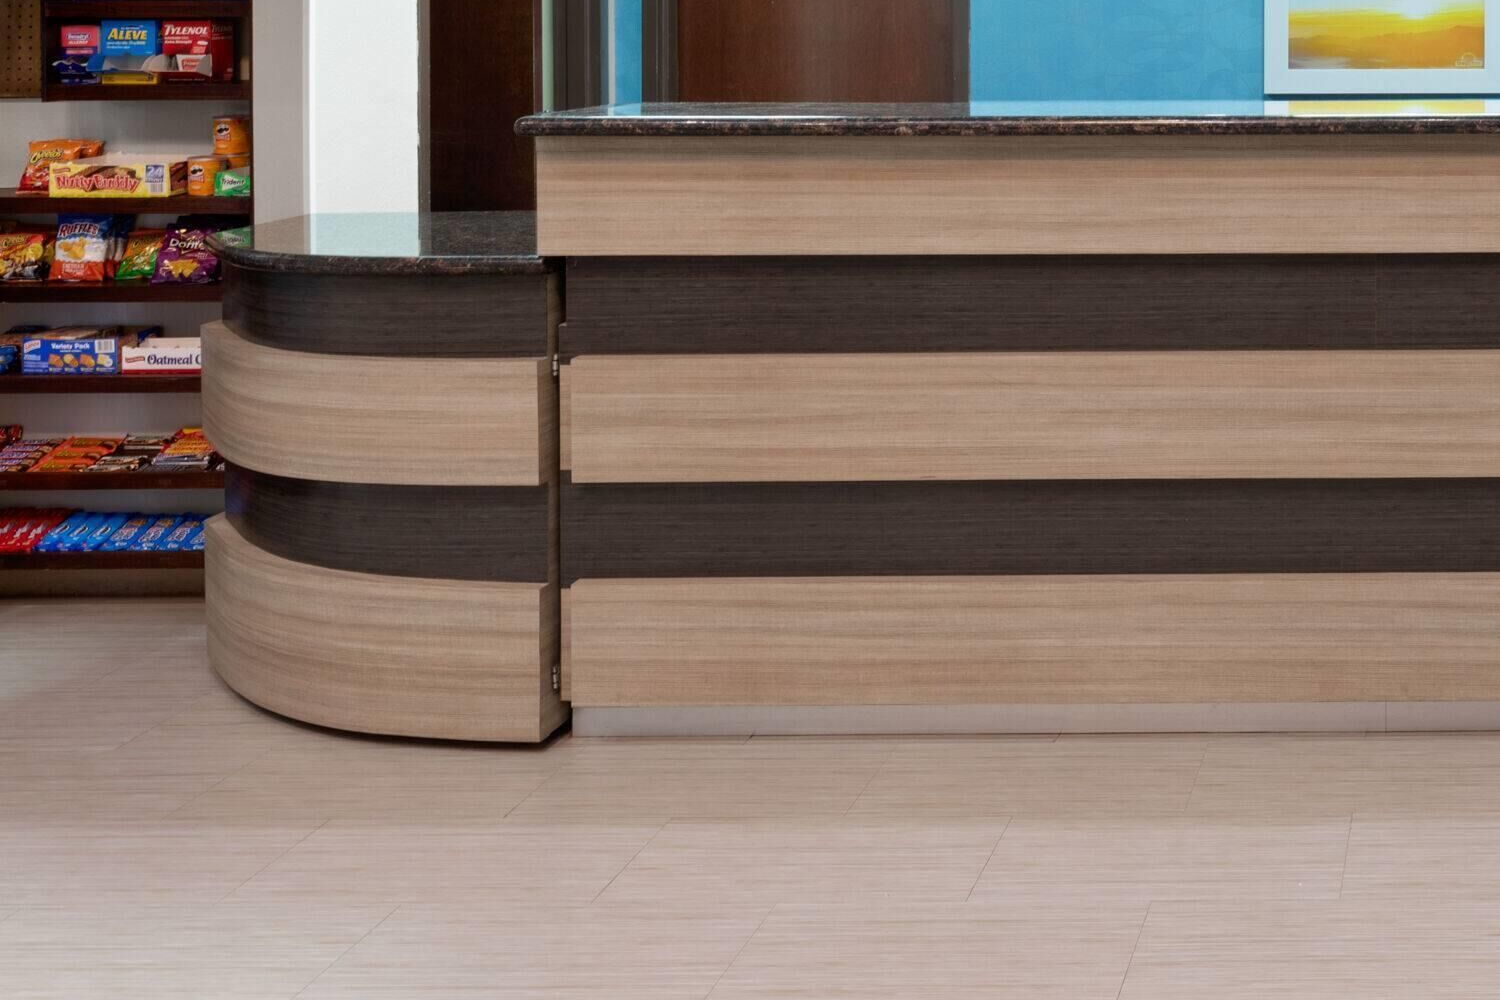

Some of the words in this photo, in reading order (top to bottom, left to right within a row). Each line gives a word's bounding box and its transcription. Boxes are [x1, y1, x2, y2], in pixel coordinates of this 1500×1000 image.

[107, 27, 148, 41] ALEVE
[164, 23, 209, 36] TYLENOL
[147, 166, 164, 178] 24
[56, 174, 95, 192] Nutty
[94, 174, 140, 193] Buddy
[221, 177, 246, 186] Trident
[58, 221, 99, 238] RUFFLES
[50, 342, 73, 351] Variety
[74, 342, 91, 350] Pack
[147, 353, 193, 365] Oatmeal
